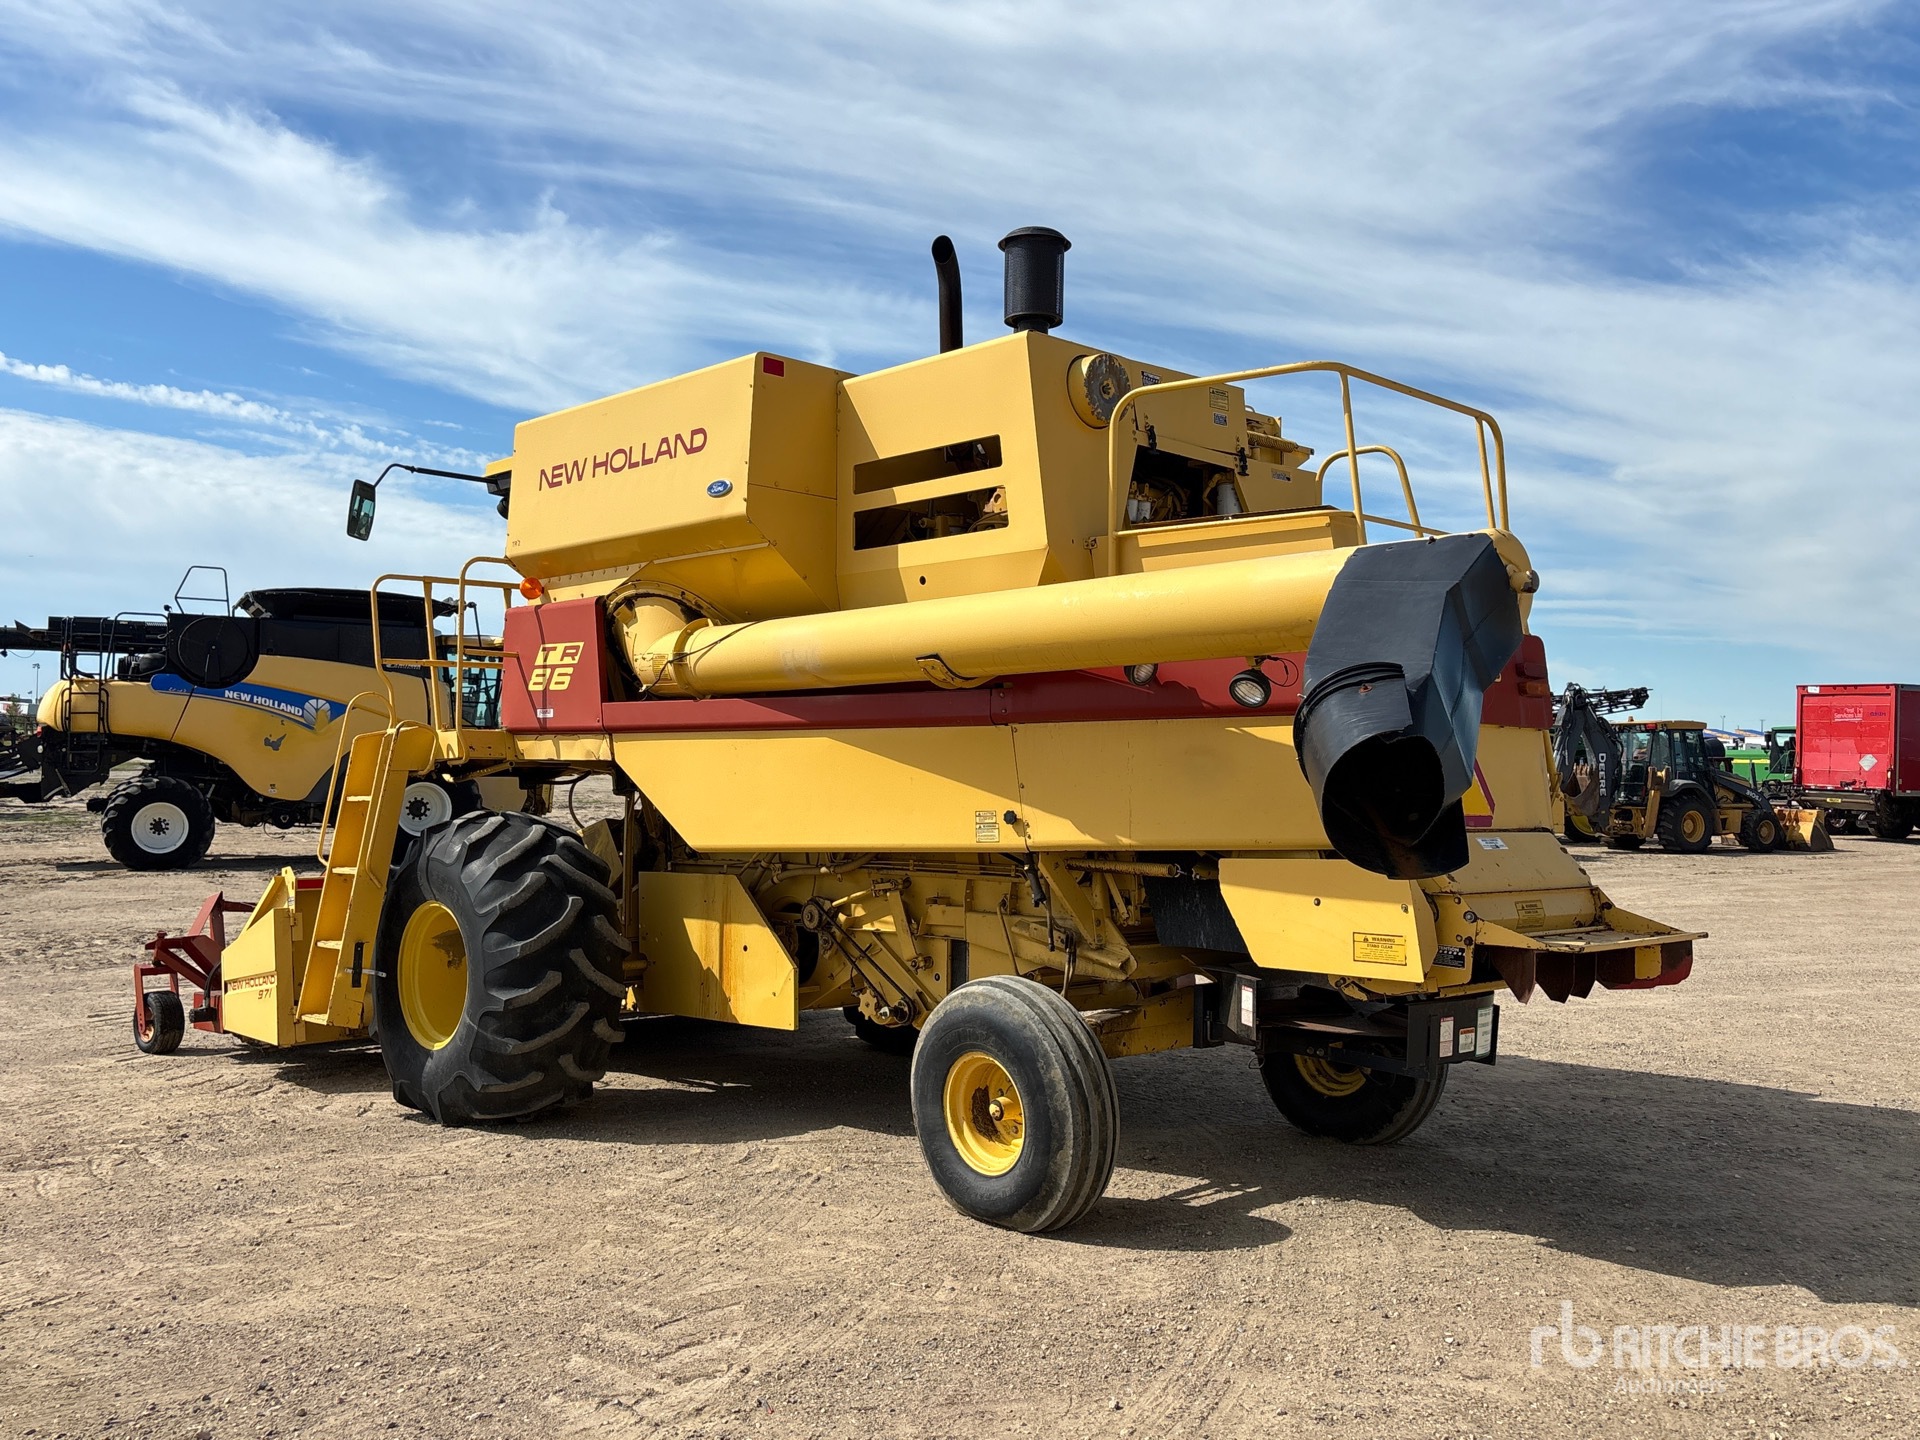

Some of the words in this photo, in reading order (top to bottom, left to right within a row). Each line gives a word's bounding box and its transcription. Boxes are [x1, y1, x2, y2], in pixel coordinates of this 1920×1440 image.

[539, 457, 588, 491] NEW
[592, 427, 708, 478] HOLLAND
[539, 644, 582, 663] TR
[528, 667, 574, 691] 86
[224, 689, 252, 702] NEW
[253, 695, 303, 716] HOLLAND
[1598, 753, 1607, 797] DEERE
[228, 980, 244, 991] NEW
[245, 974, 276, 989] HOLLAND
[258, 988, 272, 1000] 971
